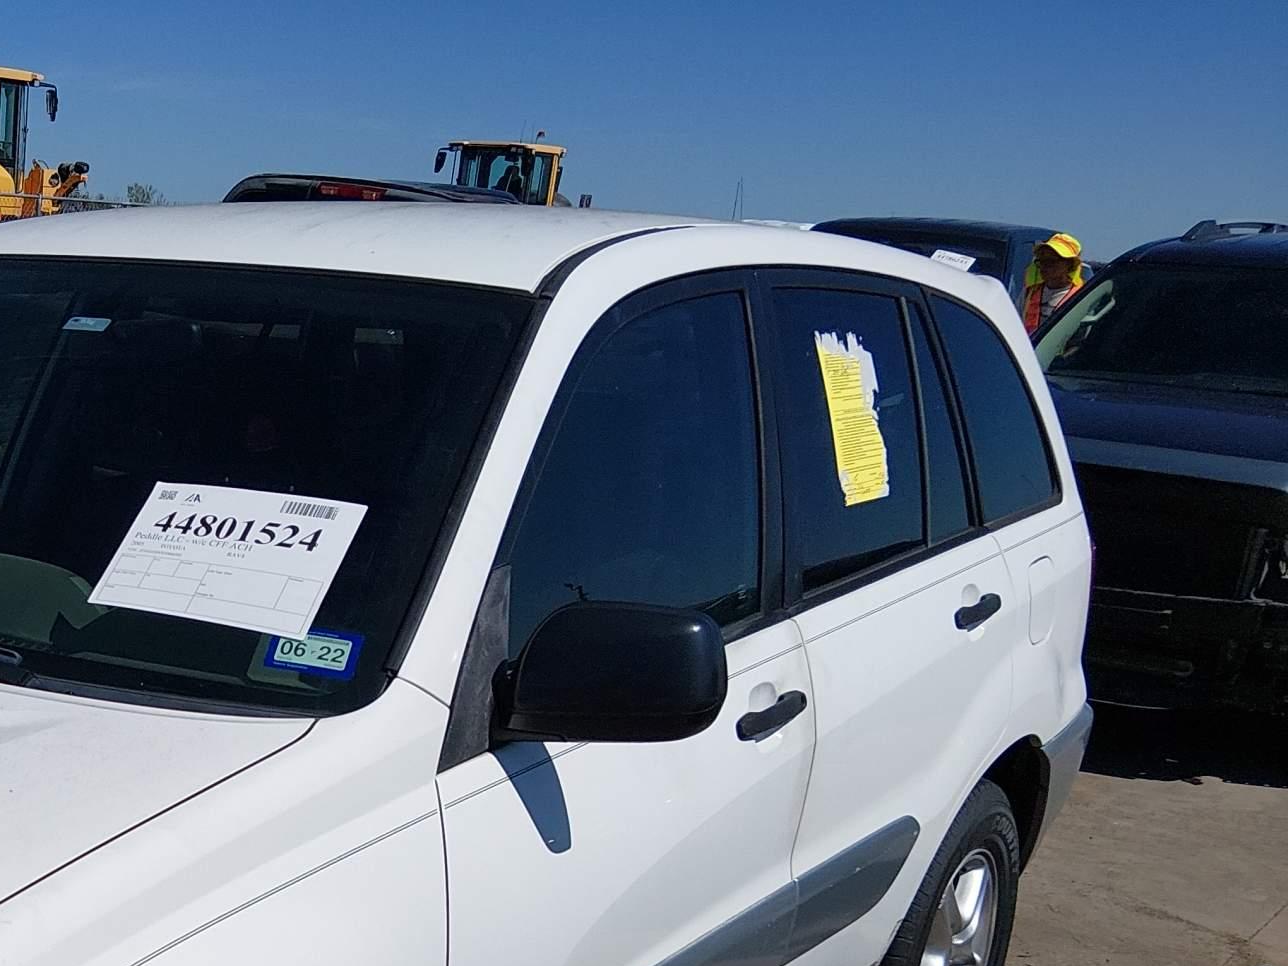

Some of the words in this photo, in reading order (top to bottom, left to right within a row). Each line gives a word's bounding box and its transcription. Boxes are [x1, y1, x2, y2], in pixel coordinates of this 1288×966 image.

[135, 531, 163, 541] Peddle
[164, 535, 184, 544] LLC
[229, 543, 253, 552] ACH
[154, 511, 323, 552] 44801524
[280, 640, 307, 657] 06
[317, 646, 345, 663] 22
